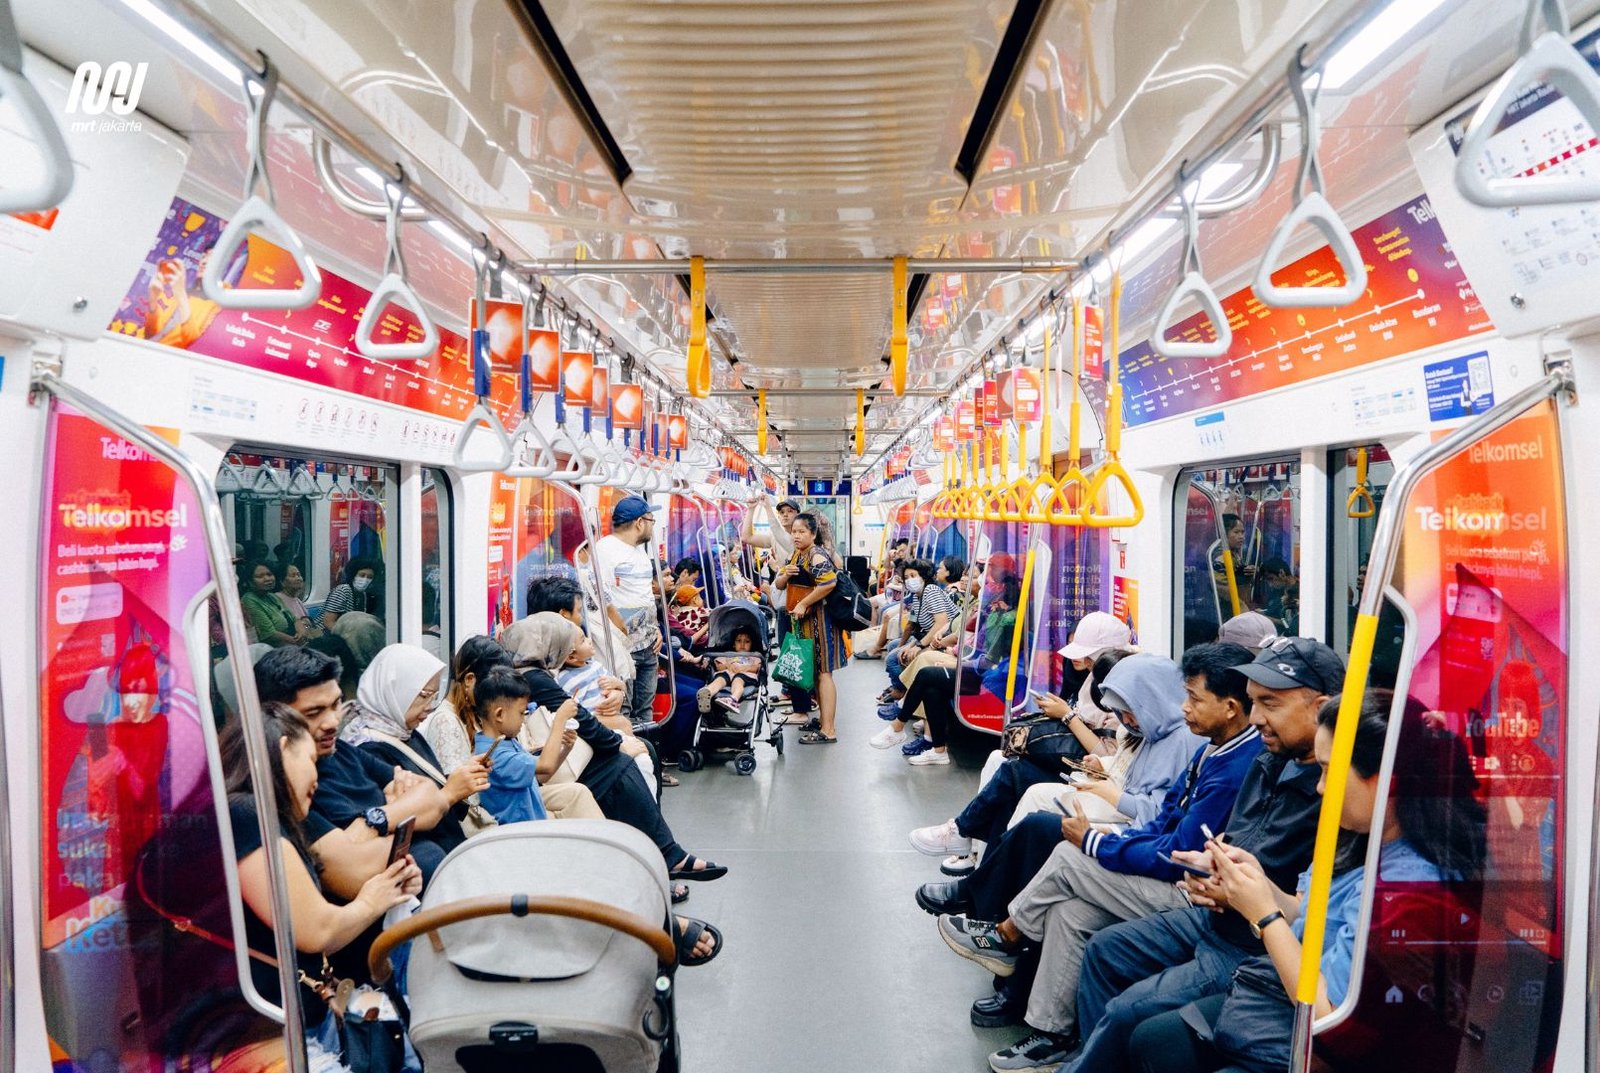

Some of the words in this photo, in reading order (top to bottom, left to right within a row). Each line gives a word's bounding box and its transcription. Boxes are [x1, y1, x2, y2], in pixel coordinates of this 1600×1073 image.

[1469, 435, 1543, 463] Telkomsel
[58, 503, 187, 528] Telkomsel
[1415, 505, 1547, 531] Telkomsel
[1463, 711, 1539, 738] YouTube
